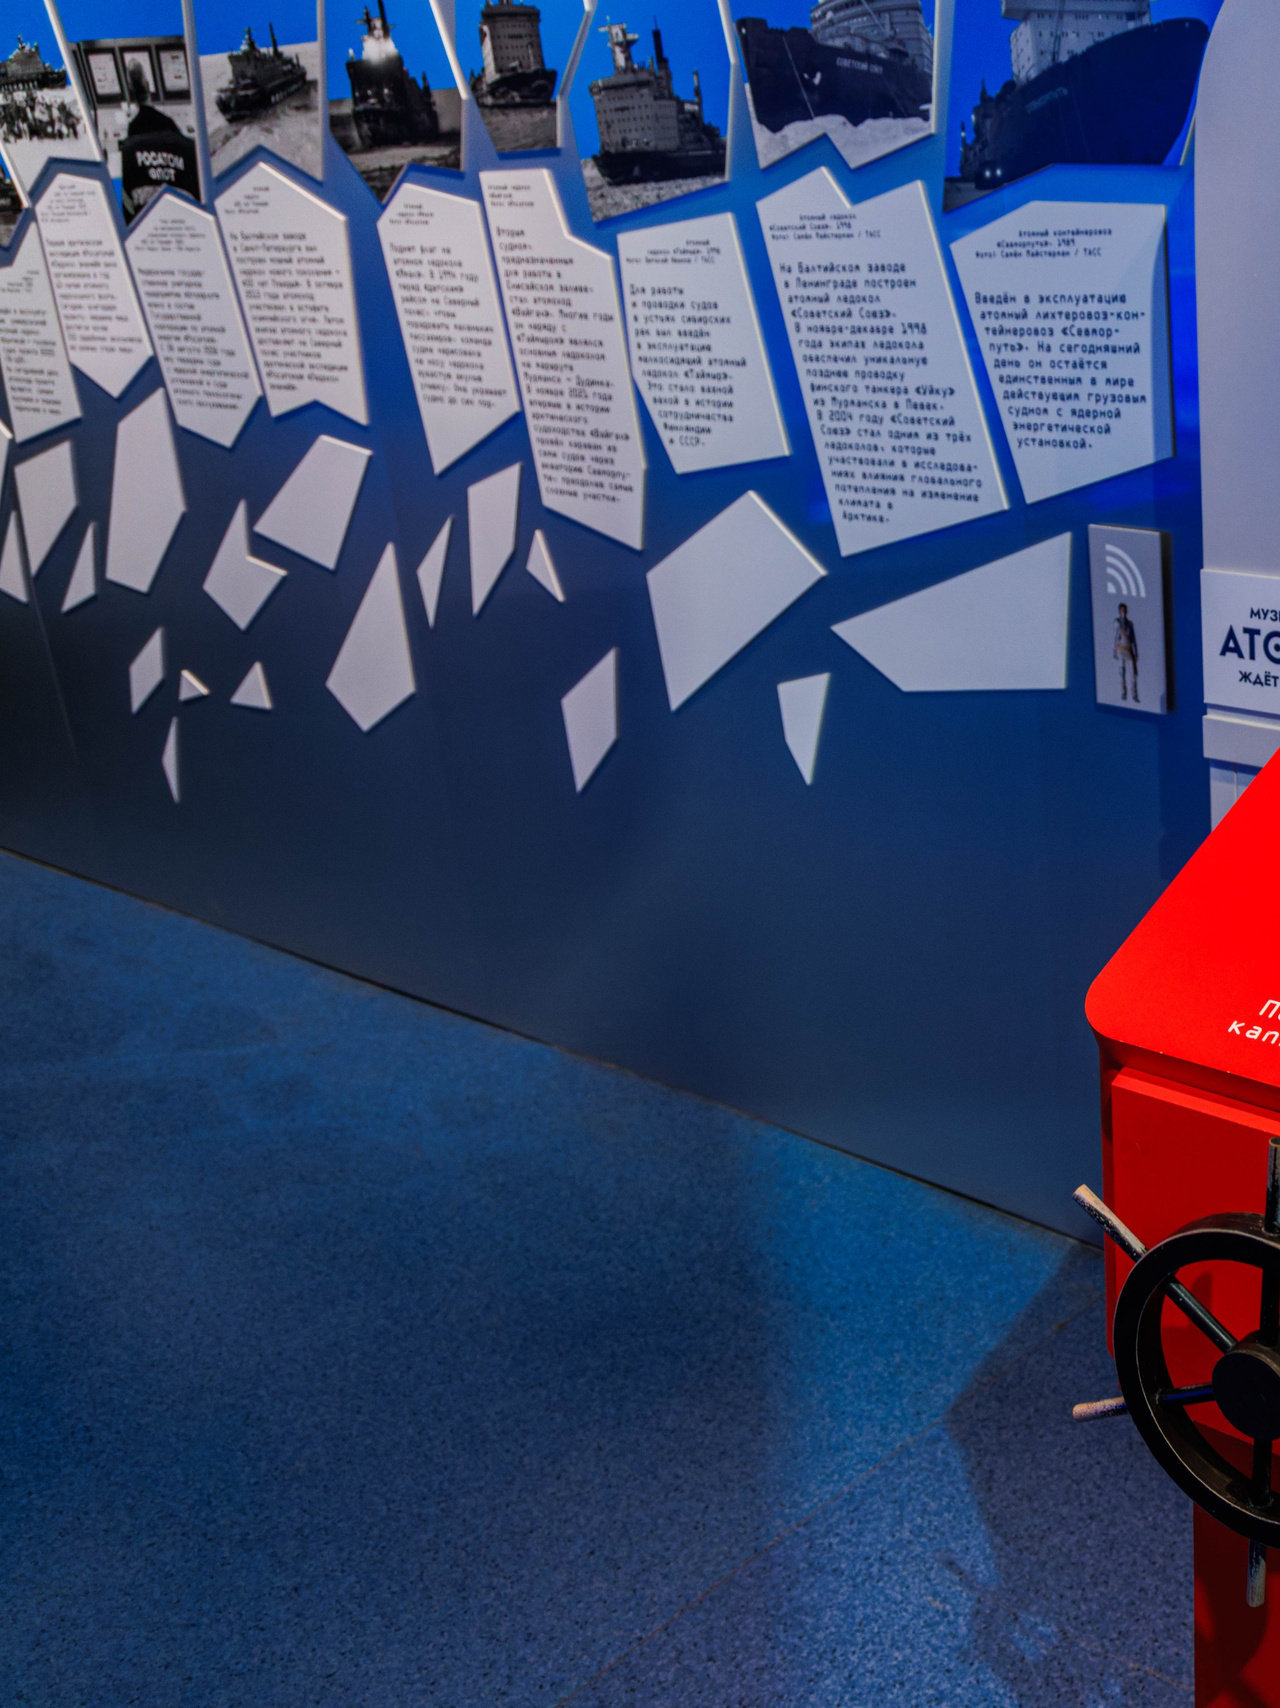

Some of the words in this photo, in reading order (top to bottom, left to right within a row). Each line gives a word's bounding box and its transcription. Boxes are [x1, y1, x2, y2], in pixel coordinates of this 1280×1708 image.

[135, 150, 185, 171] РОСАТОМ
[1083, 248, 1102, 257] ТАСС
[974, 291, 1017, 306] Введён
[1024, 294, 1031, 305] в
[1038, 293, 1127, 308] эксплуатацию
[980, 308, 1029, 321] атомный
[984, 324, 1055, 339] тейнеровоз
[1061, 324, 1120, 340] «Севмор-
[989, 342, 1030, 356] путь».
[1037, 340, 1052, 354] На
[1059, 342, 1141, 356] сегодняшний
[994, 358, 1022, 370] день
[1028, 359, 1043, 370] он
[1049, 357, 1108, 371] остаётся
[998, 374, 1083, 386] единственным
[1090, 376, 1098, 387] в
[1105, 377, 1135, 390] мире
[1087, 392, 1147, 406] грузовым
[1008, 405, 1049, 418] судном
[1056, 407, 1064, 418] с
[1070, 407, 1122, 422] ядерной
[1012, 421, 1112, 436] энергетической
[1017, 437, 1093, 450] установкой.
[1238, 670, 1280, 688] ЖДЁТ
